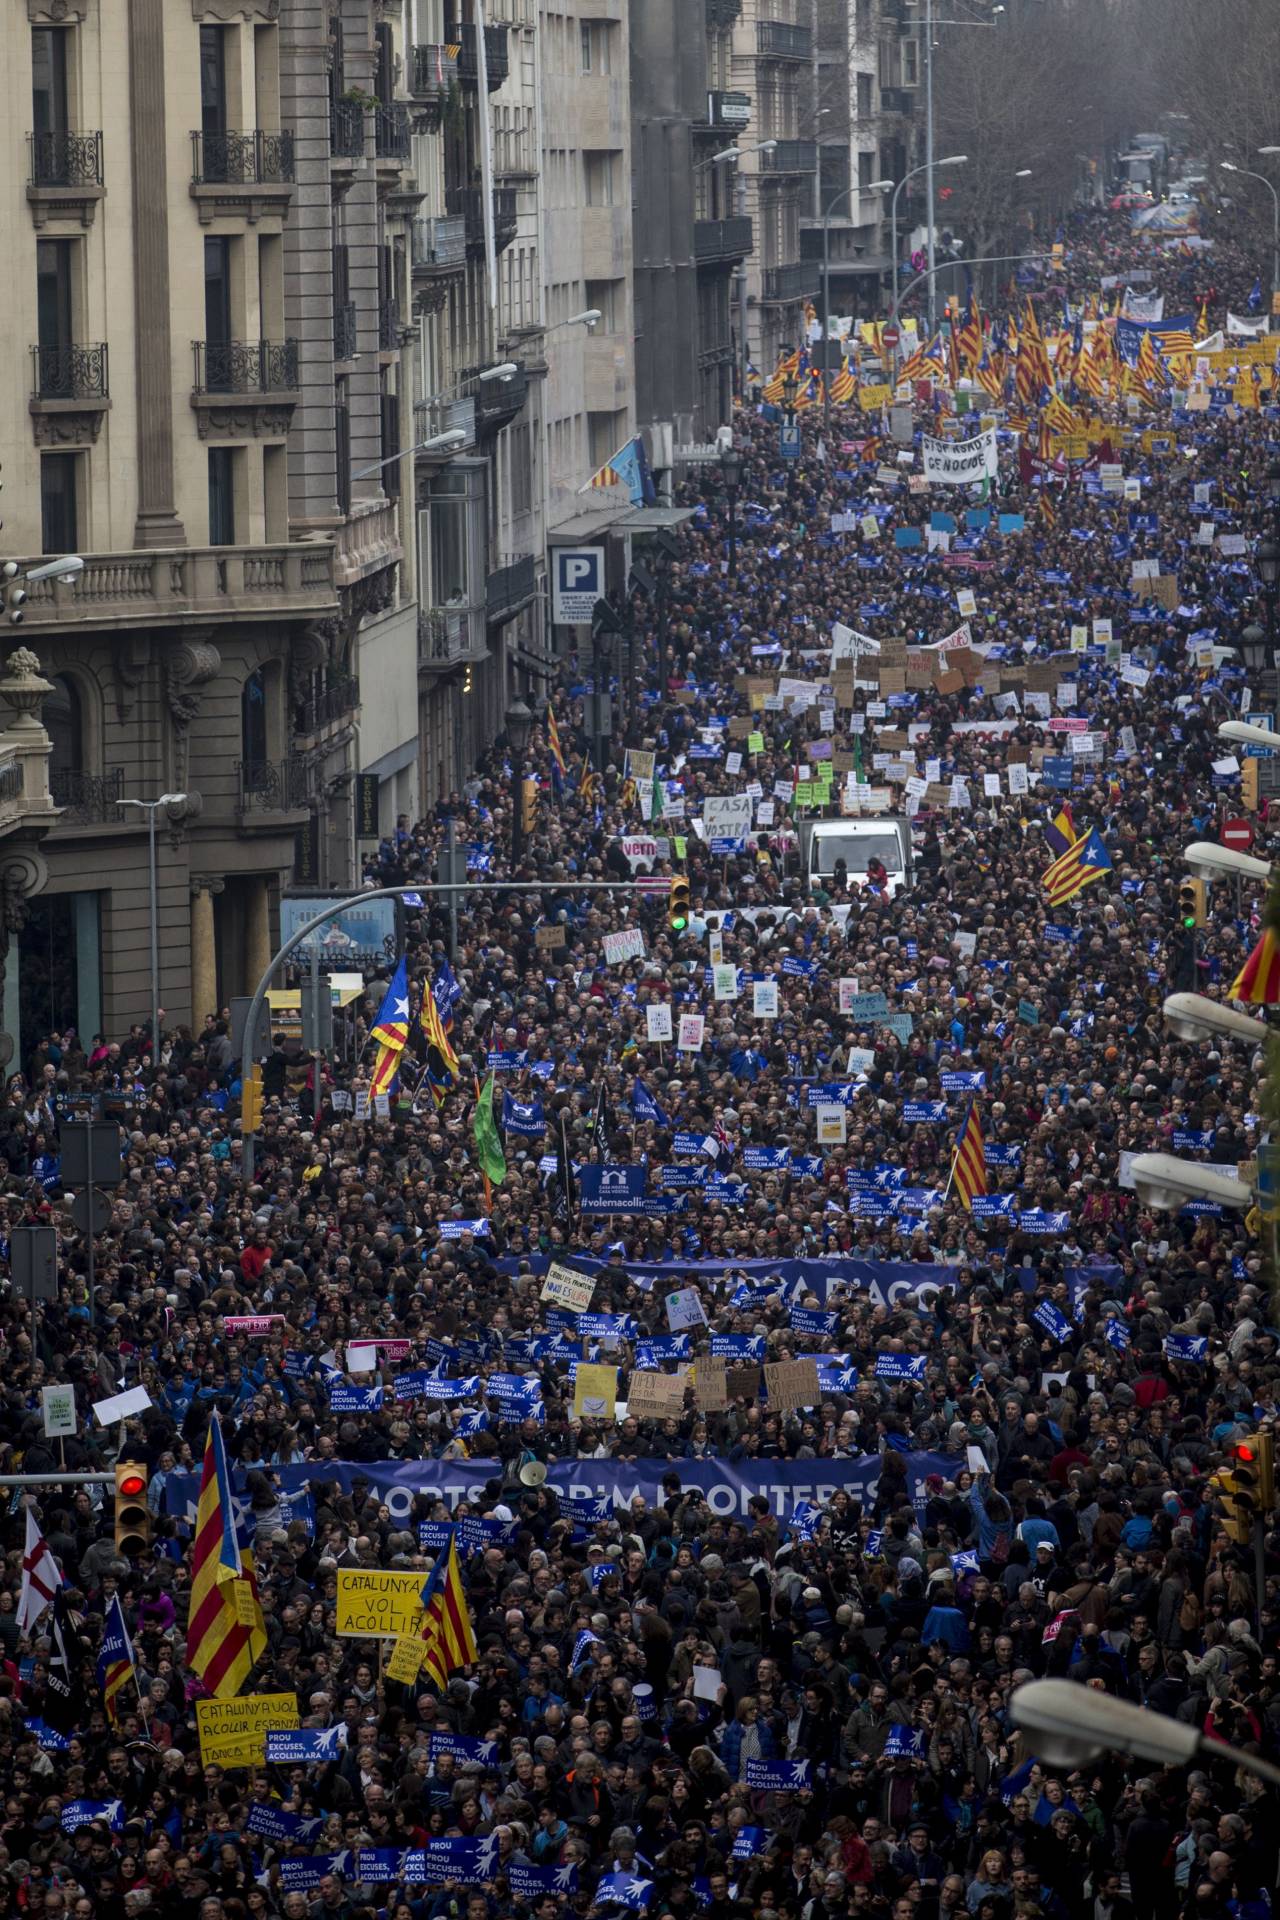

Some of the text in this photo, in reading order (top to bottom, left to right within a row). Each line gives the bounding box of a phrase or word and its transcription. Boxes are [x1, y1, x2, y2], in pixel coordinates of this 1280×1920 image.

[929, 454, 986, 472] GENOCIDE
[566, 559, 591, 588] P
[709, 800, 750, 813] CASA
[704, 822, 750, 837] VOSTRA
[581, 1197, 645, 1209] #volemacollir
[342, 1576, 420, 1594] CATALUNYA
[365, 1599, 404, 1614] VOL
[345, 1615, 422, 1637] ACOLLIR
[200, 1702, 298, 1720] CATALUNYA VOL
[204, 1719, 300, 1736] ACOLLIR ESPANYA
[269, 1734, 291, 1742] PROU
[432, 1736, 455, 1745] PROU
[203, 1747, 243, 1761] TANCA
[269, 1752, 322, 1760] ACOLLIM ARA
[747, 1763, 768, 1772] PROU
[253, 1806, 276, 1819] PROU
[247, 1823, 300, 1843] ACOLLIM ARA
[430, 1842, 452, 1850] PROU
[360, 1853, 376, 1862] PROU
[427, 1854, 450, 1863] PROU
[281, 1862, 304, 1871] PROU
[360, 1873, 389, 1881] ACOLLIM
[510, 1868, 529, 1878] PROU
[284, 1880, 321, 1890] ACOLLIM
[464, 1875, 481, 1884] ARA
